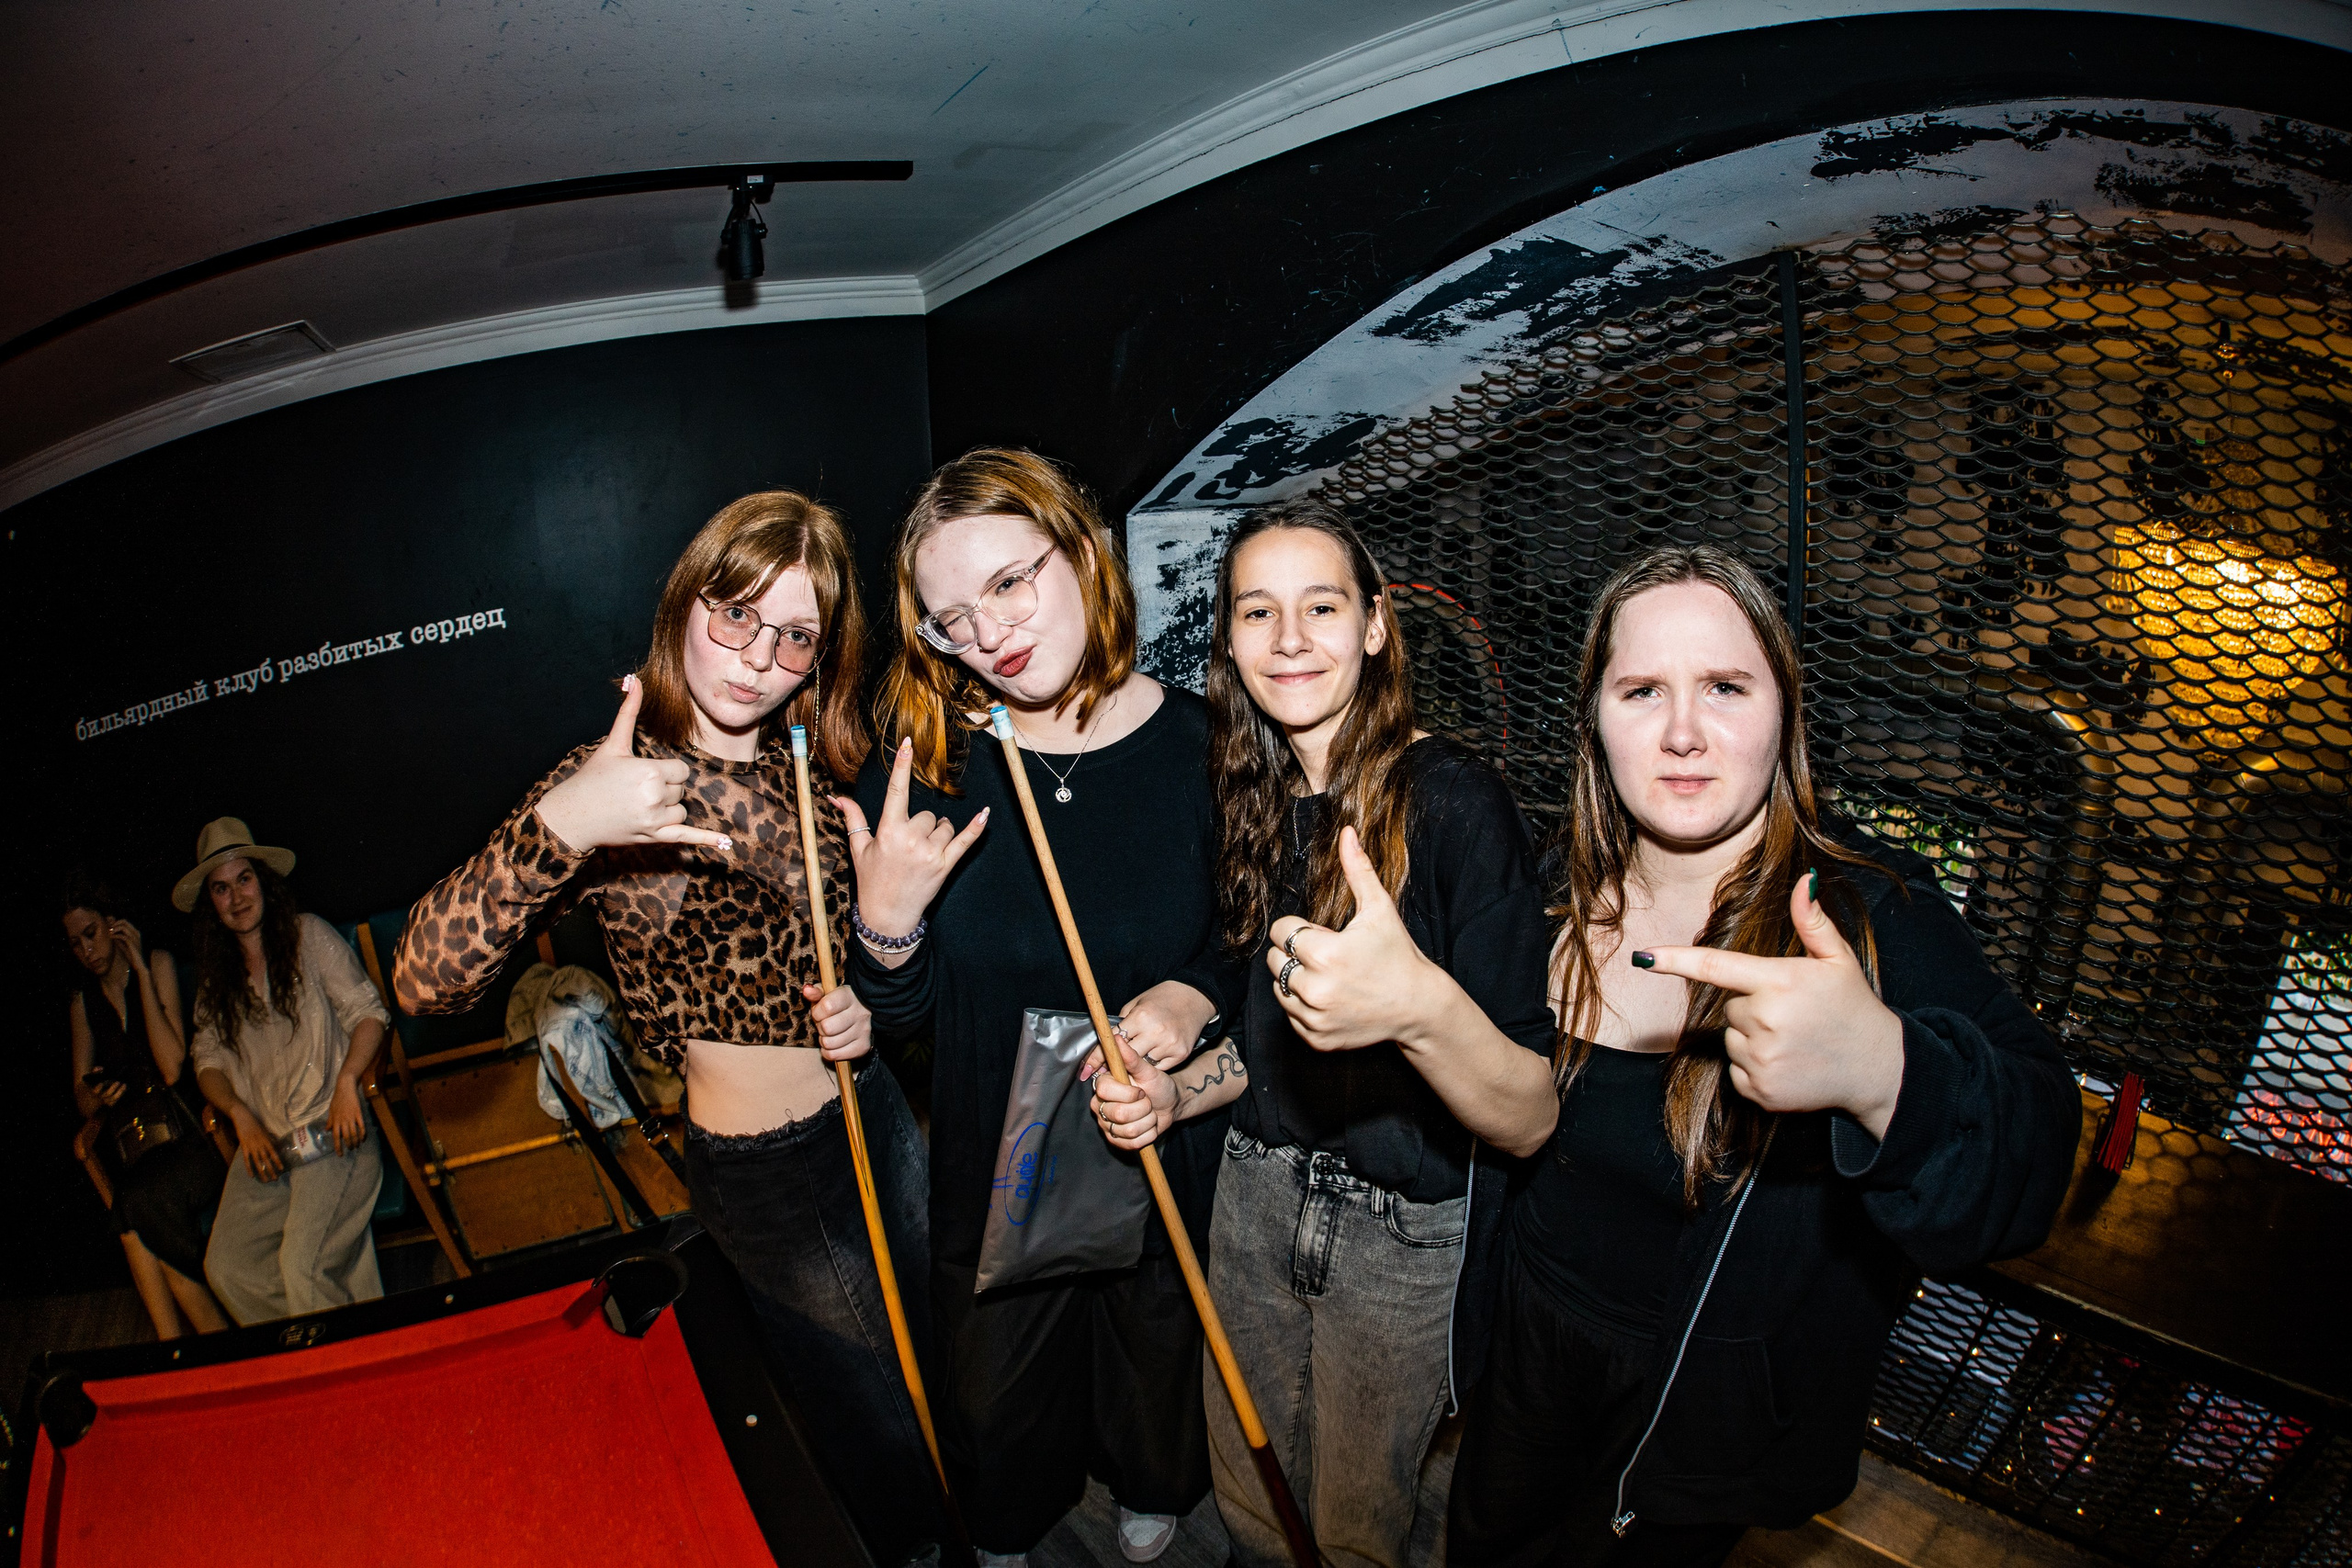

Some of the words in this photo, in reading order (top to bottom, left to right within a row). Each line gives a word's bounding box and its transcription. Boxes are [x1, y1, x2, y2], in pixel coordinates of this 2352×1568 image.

[75, 679, 209, 741] бильярдный
[214, 658, 275, 697] клуб
[277, 631, 404, 683] разбитых
[410, 607, 506, 644] сердец
